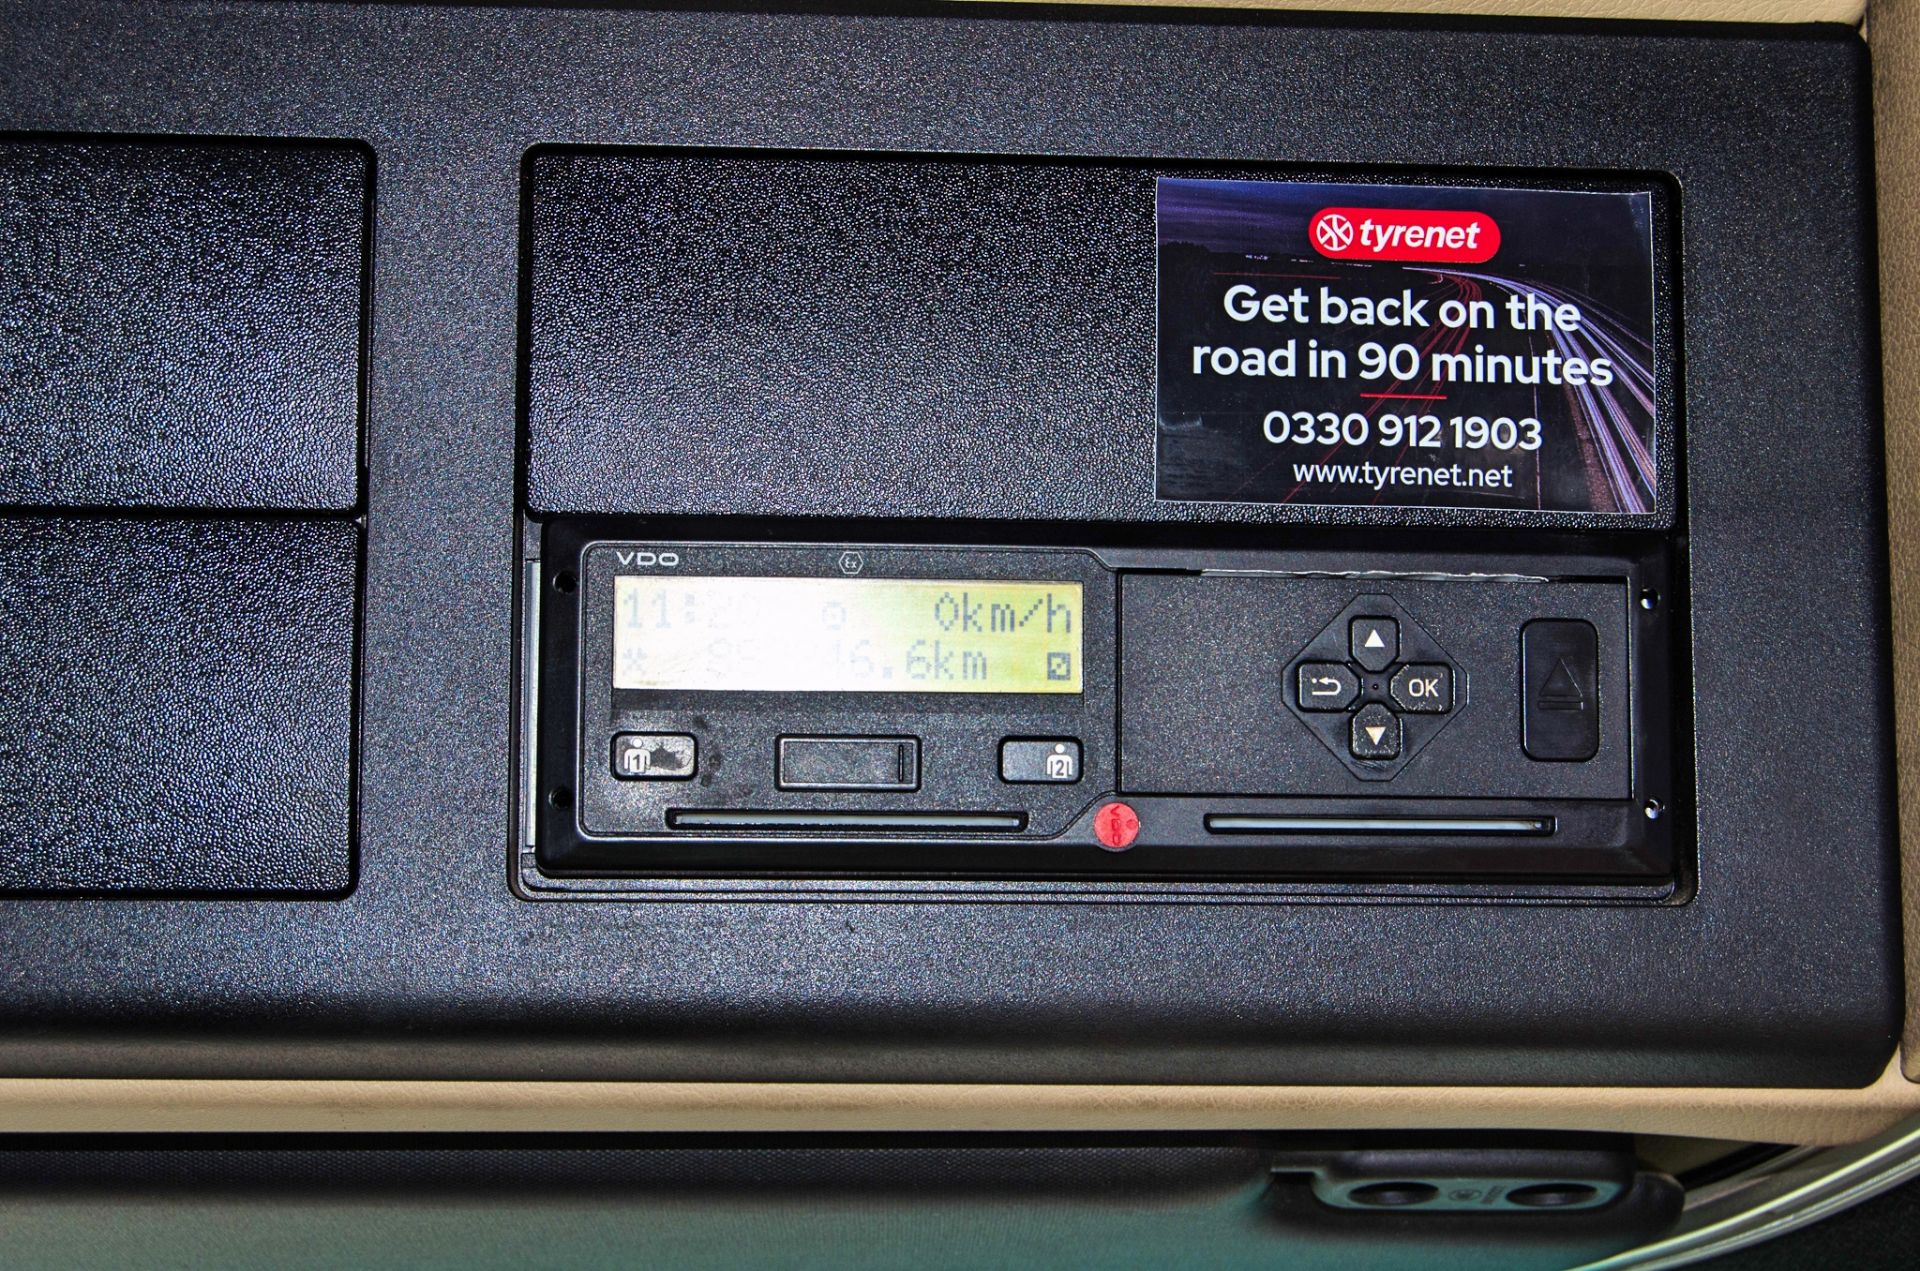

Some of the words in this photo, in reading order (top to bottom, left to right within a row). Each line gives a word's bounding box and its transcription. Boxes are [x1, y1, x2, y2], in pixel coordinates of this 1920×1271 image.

[1360, 219, 1481, 253] tyrenet
[1223, 284, 1309, 323] Get
[1320, 286, 1430, 328] back
[1438, 300, 1494, 330] on
[1505, 292, 1581, 332] the
[1193, 340, 1296, 377] road
[1308, 340, 1346, 378] in
[1358, 342, 1420, 381] 90
[1432, 345, 1614, 387] minutes
[1263, 411, 1369, 445] 0330
[1378, 415, 1442, 448] 912
[1449, 417, 1542, 451] 1903
[1293, 461, 1513, 492] www.tyrenet.net
[616, 551, 680, 567] VDO
[1408, 677, 1439, 699] OK
